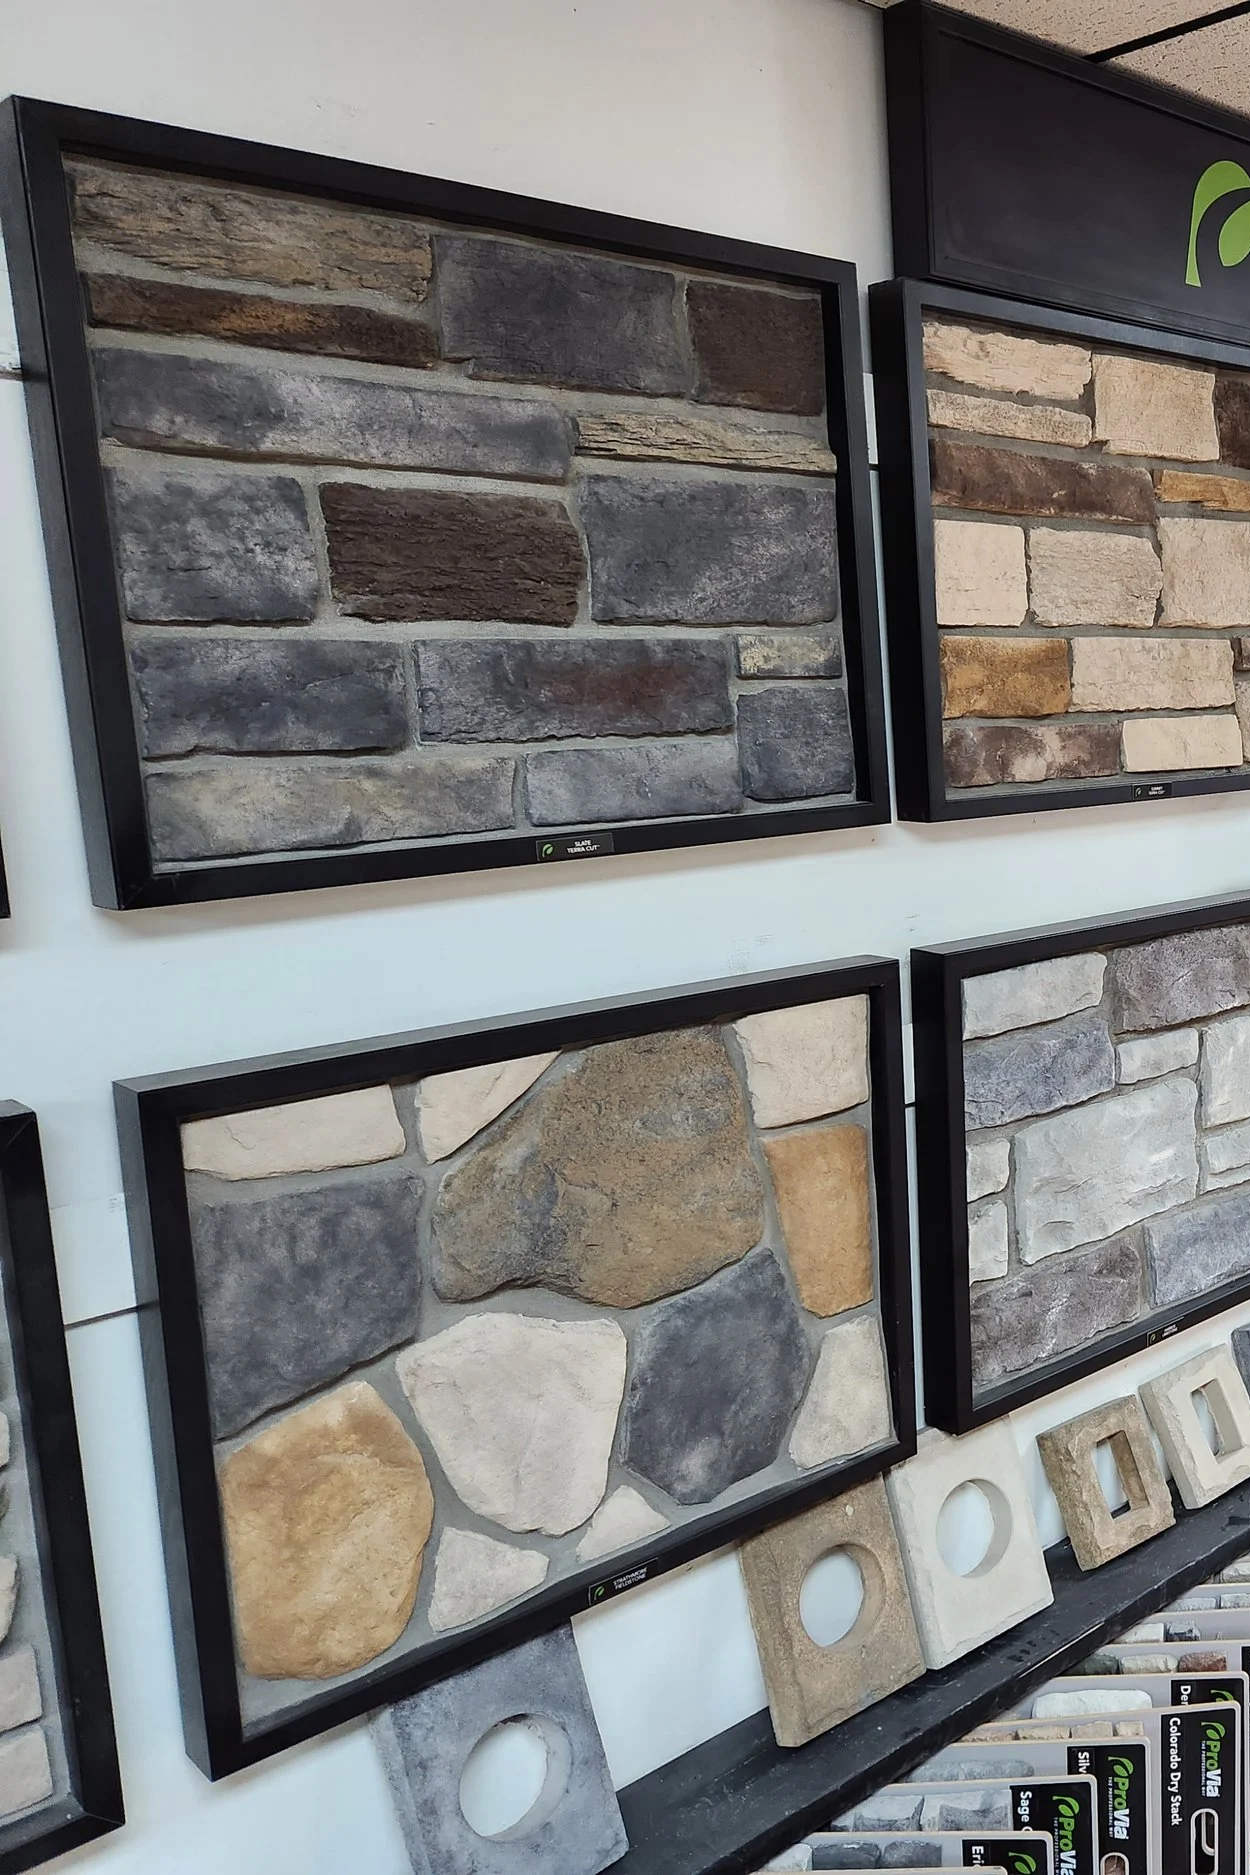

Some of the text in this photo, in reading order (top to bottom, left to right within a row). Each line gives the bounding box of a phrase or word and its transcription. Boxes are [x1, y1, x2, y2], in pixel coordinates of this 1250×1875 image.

[1167, 1717, 1182, 1826] Colorado Dry Stack
[1206, 1741, 1221, 1797] ProVia
[1018, 1791, 1032, 1822] Sage
[1114, 1777, 1129, 1840] ProVia
[1059, 1817, 1076, 1875] ProVia
